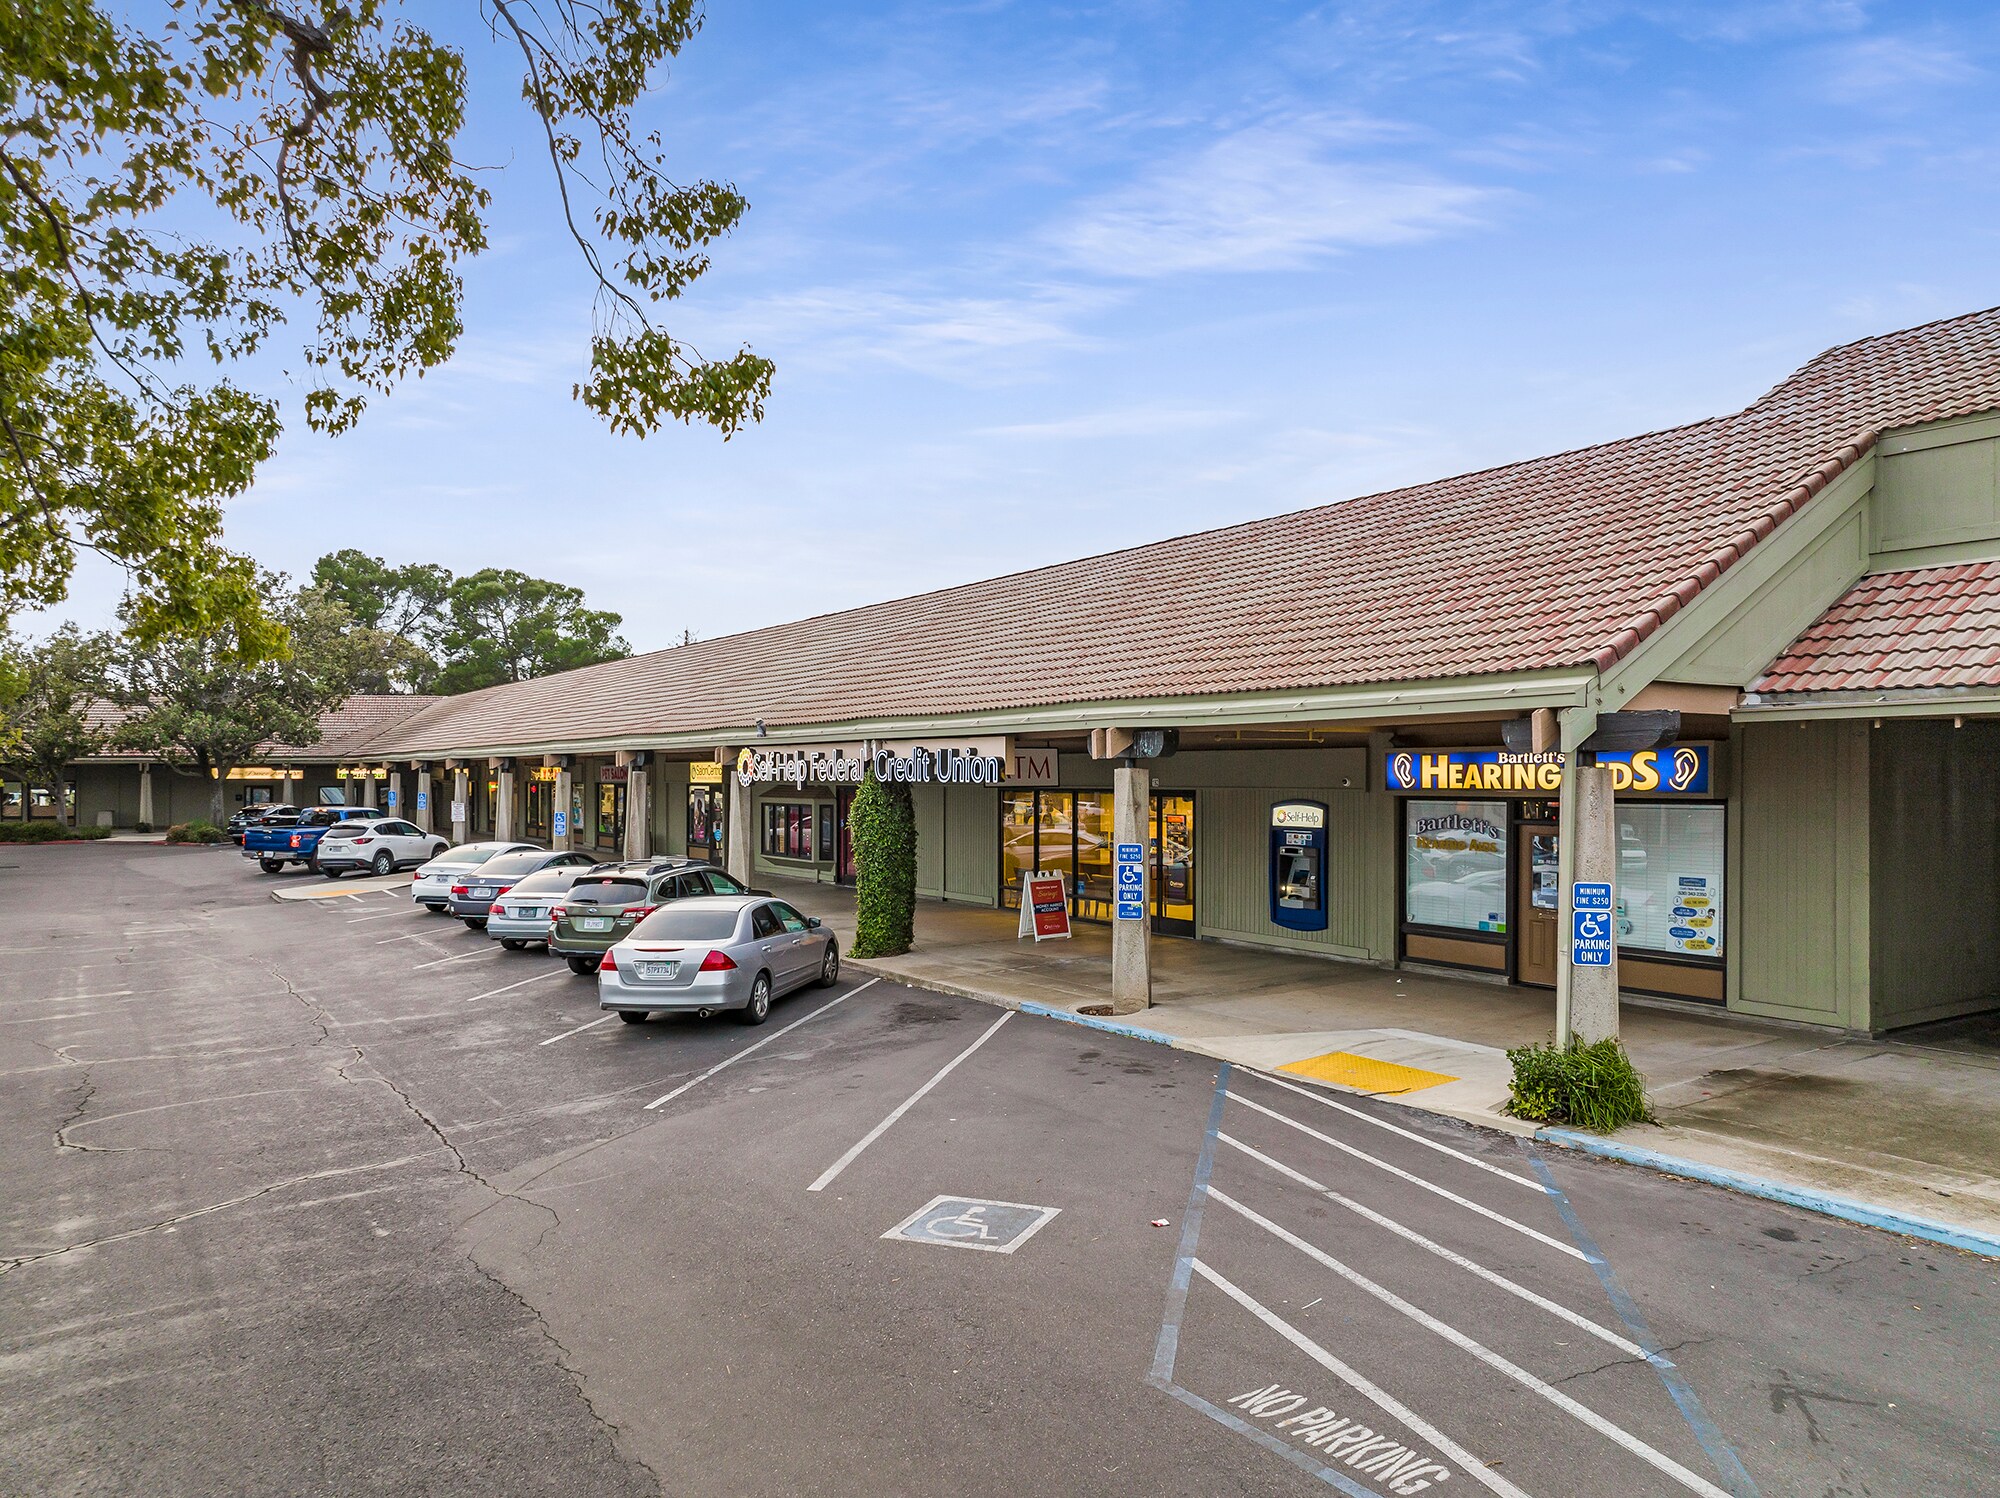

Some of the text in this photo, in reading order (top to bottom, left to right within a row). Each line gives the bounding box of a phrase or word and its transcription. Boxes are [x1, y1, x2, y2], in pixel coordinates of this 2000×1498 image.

[1498, 752, 1566, 764] Bartlett's
[753, 746, 999, 791] Self-Help Federal Credit Union
[1007, 755, 1050, 779] TM
[1421, 754, 1563, 790] HEARING
[611, 767, 628, 780] SALON
[1287, 811, 1320, 826] Self-Help
[1416, 814, 1498, 840] Bartlett's
[1119, 883, 1142, 892] PARKING
[1579, 887, 1606, 896] MINIMUM
[1123, 892, 1138, 900] ONLY
[1592, 897, 1609, 905] $250
[1575, 938, 1610, 950] PARKING
[1581, 951, 1604, 963] ONLY
[1227, 1384, 1451, 1495] NO PARKING
